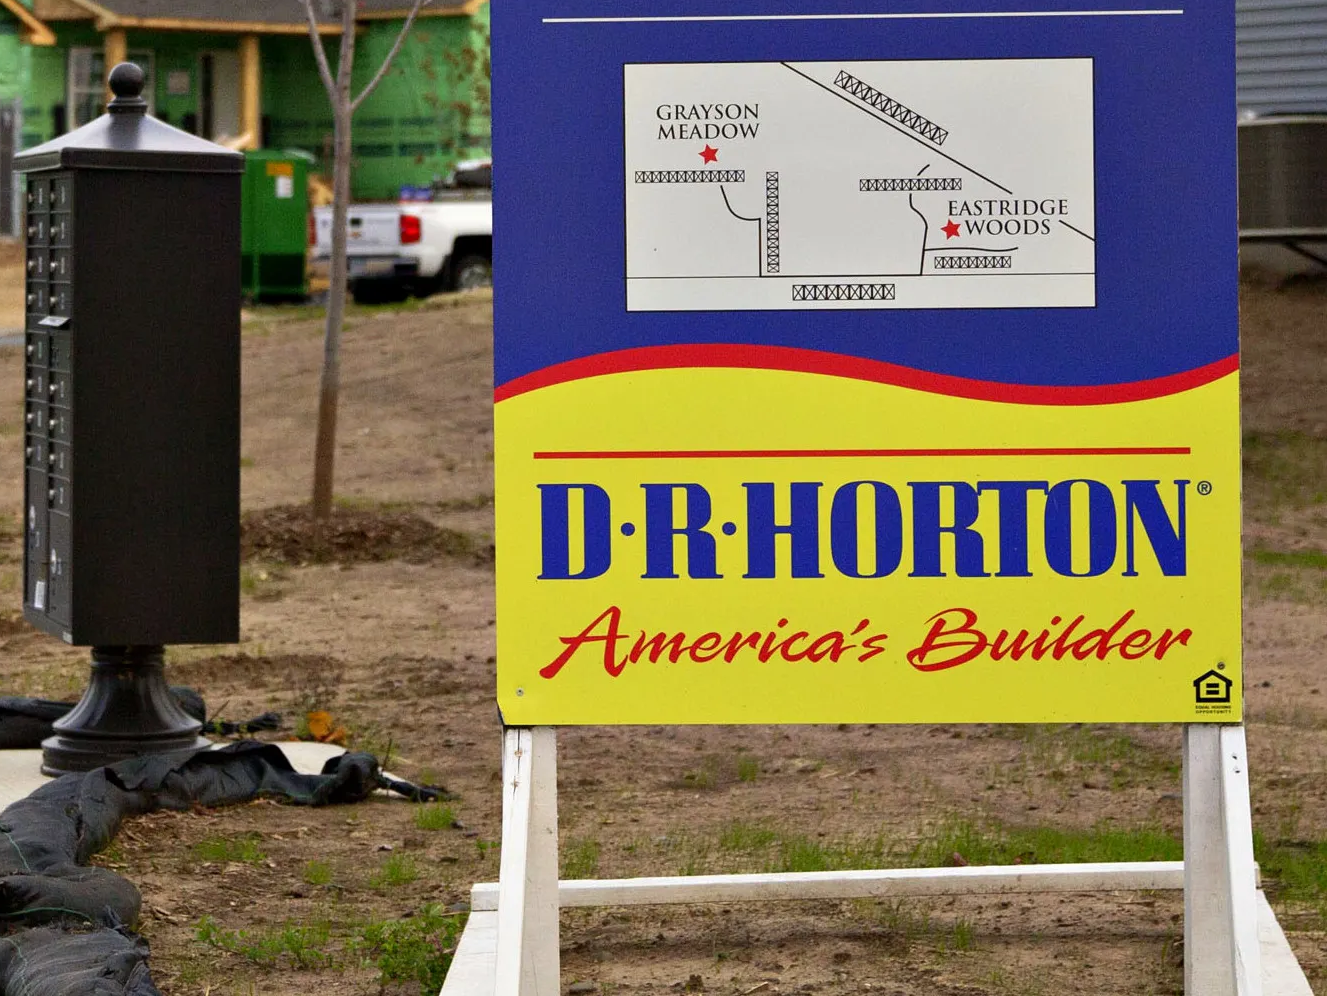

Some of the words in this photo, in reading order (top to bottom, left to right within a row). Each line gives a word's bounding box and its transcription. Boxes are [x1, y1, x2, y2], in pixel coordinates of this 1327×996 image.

[657, 104, 758, 120] GRAYSON
[659, 124, 759, 139] MEADOW
[949, 200, 1067, 215] EASTRIDGE
[965, 219, 1050, 235] WOODS
[540, 606, 886, 679] America’s
[907, 608, 1192, 671] Builder
